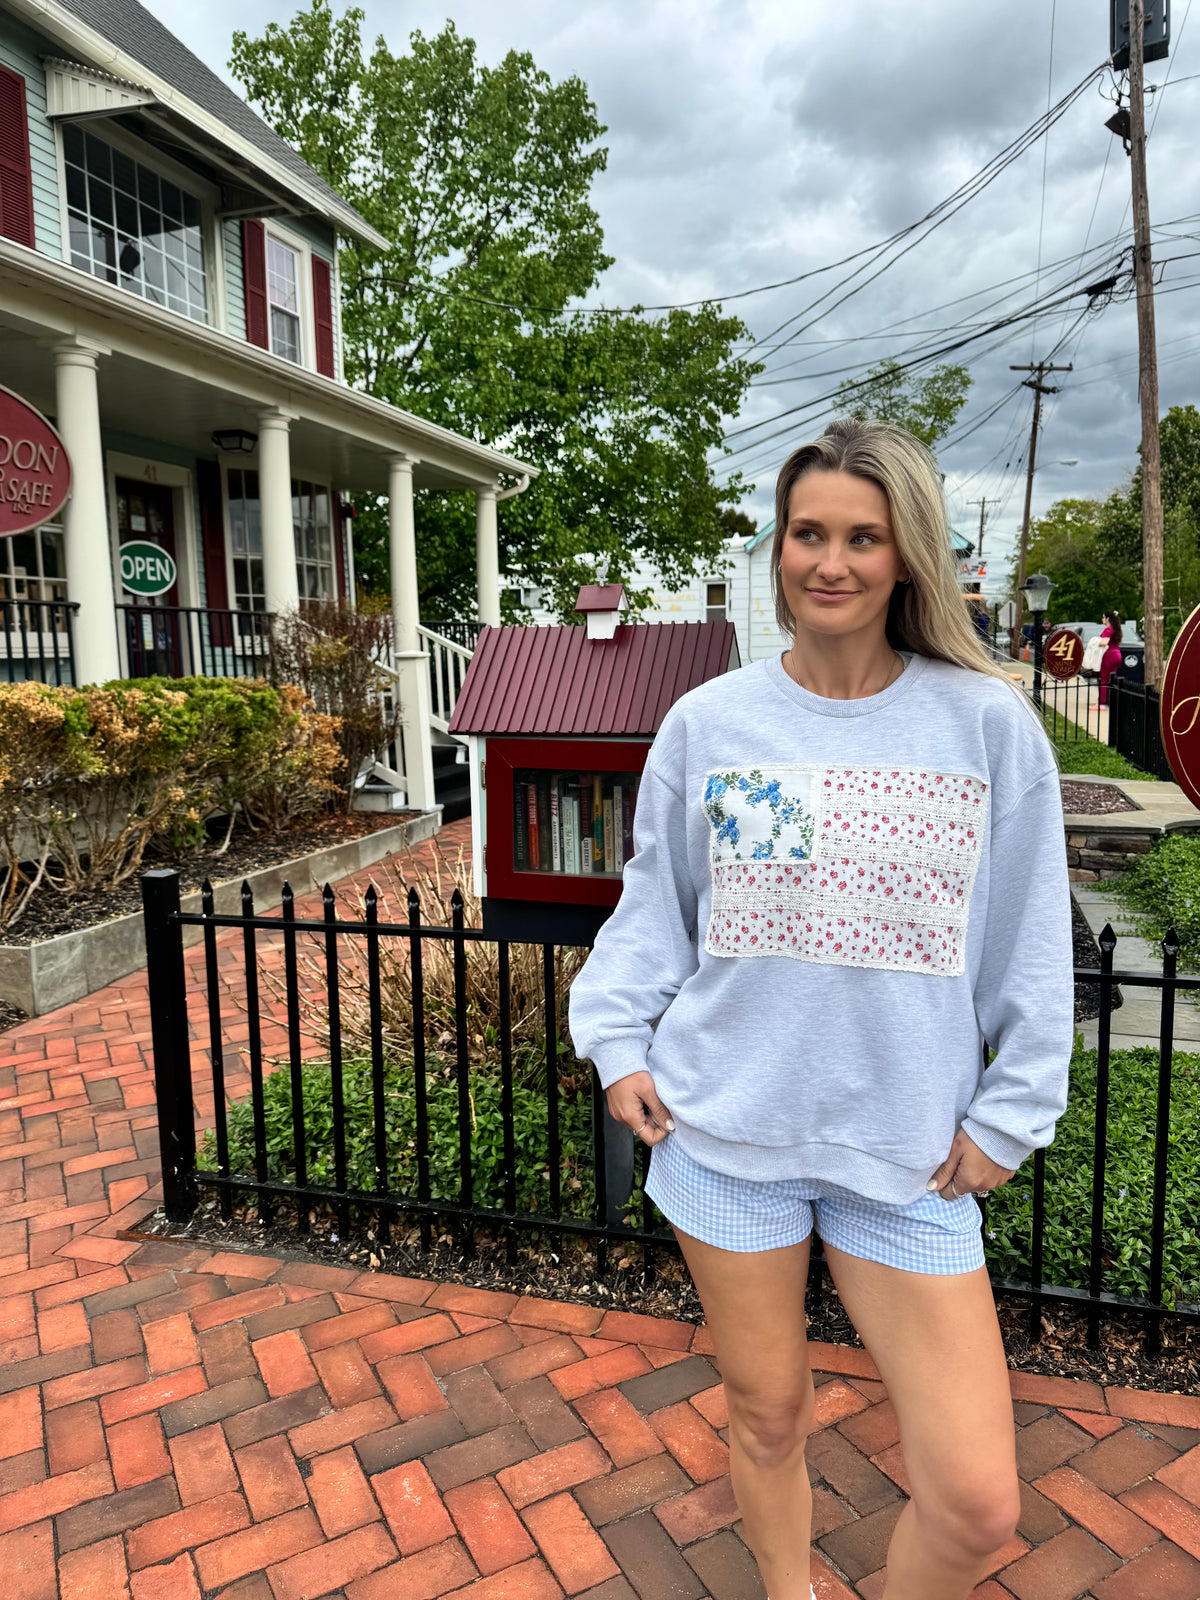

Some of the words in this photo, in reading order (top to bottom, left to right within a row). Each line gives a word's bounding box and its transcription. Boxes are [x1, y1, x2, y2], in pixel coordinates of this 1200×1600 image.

[7, 478, 53, 506] SAFE
[13, 503, 32, 513] INC
[121, 555, 170, 582] OPEN
[1049, 634, 1076, 661] 41
